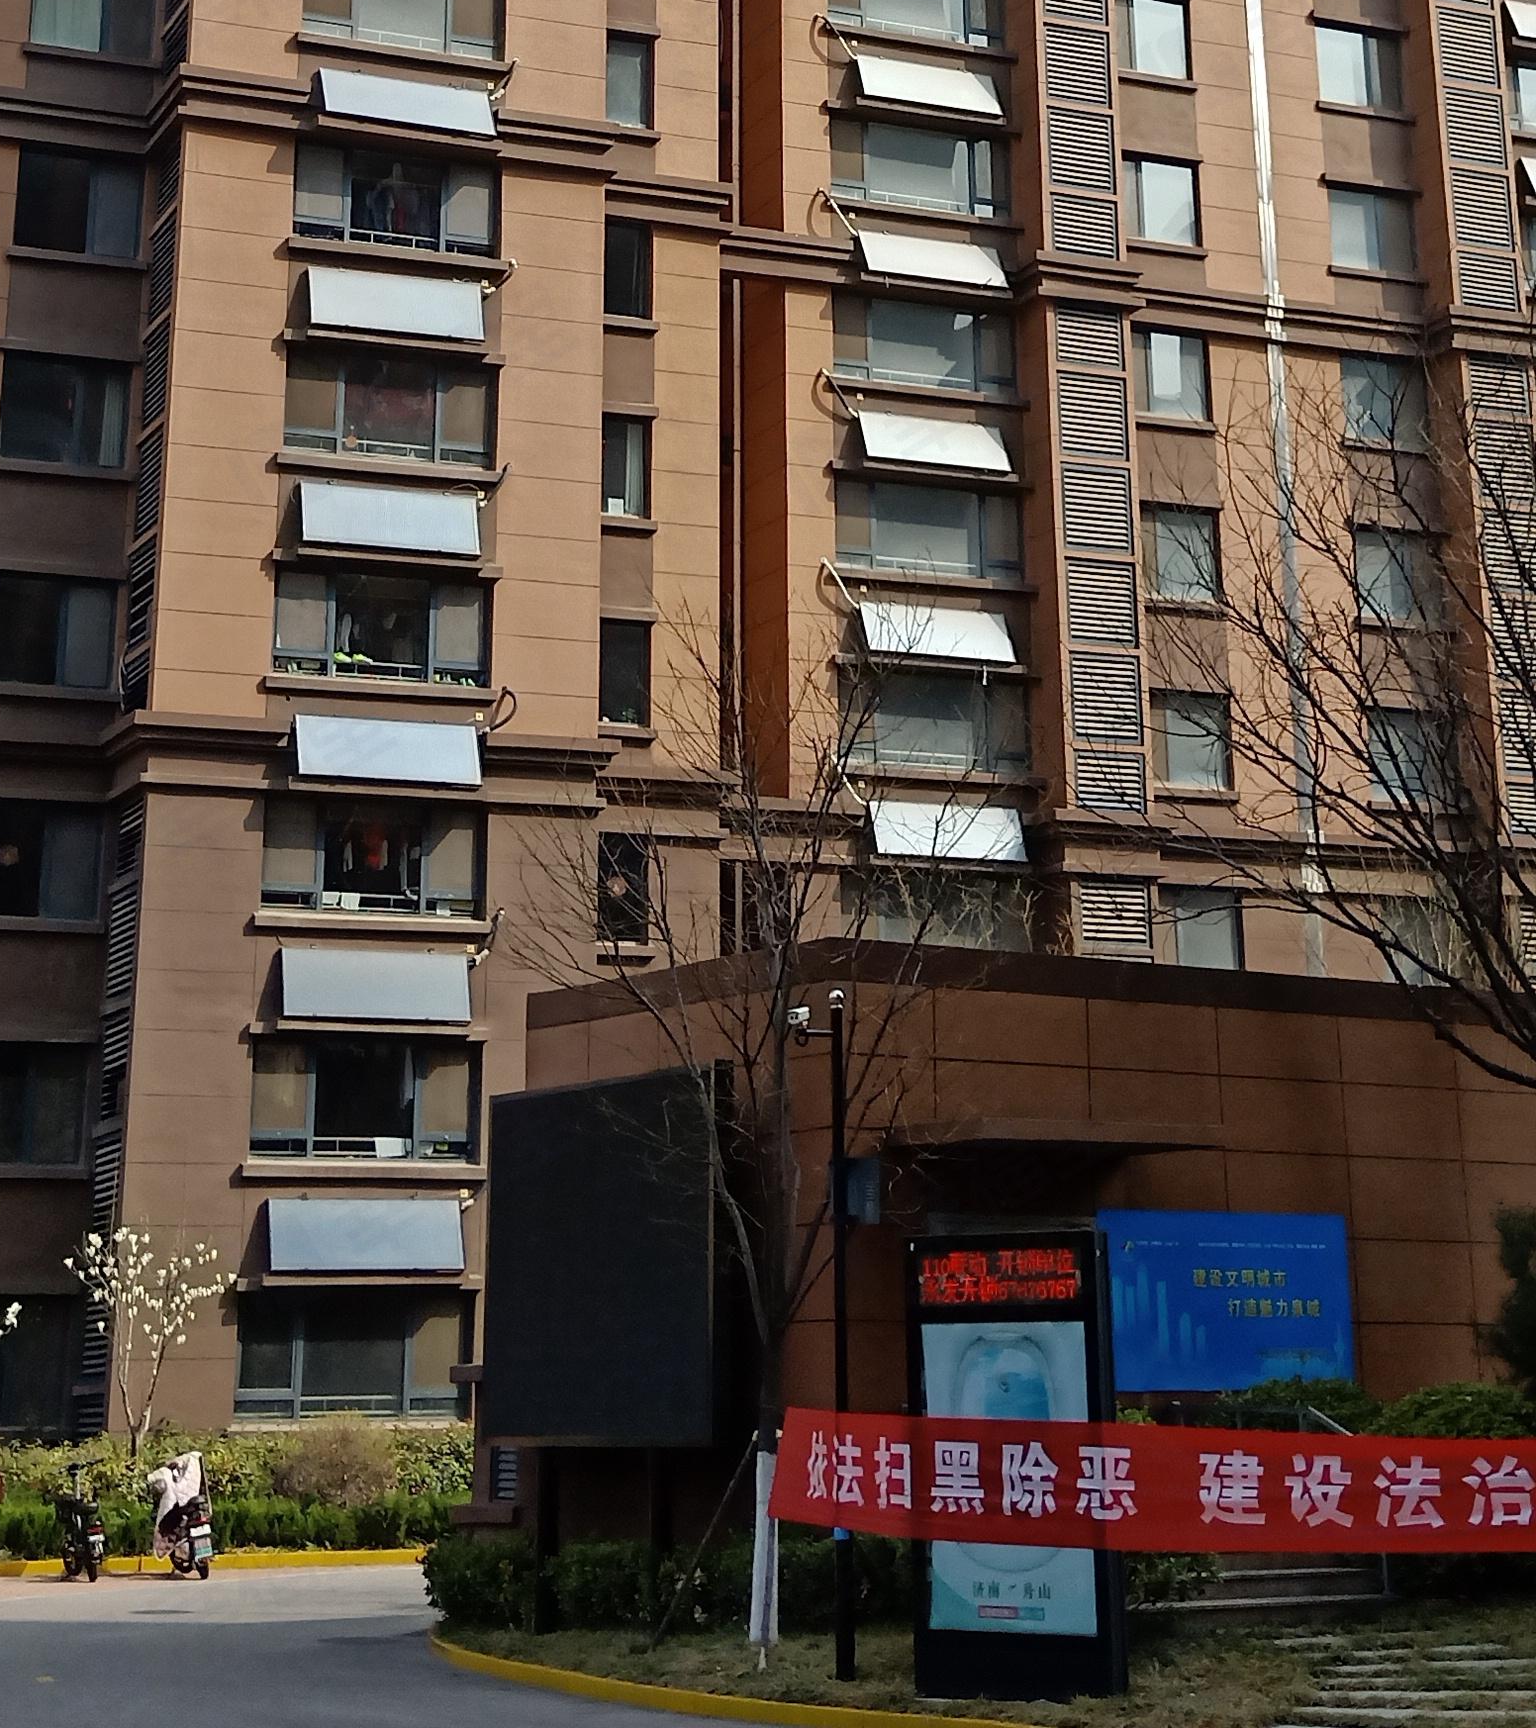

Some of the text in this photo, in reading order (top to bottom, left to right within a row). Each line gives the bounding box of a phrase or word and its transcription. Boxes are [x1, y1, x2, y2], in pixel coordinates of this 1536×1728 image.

[1192, 1268, 1287, 1288] 建设文明城市
[806, 1429, 1136, 1521] 依法扫黑除恶
